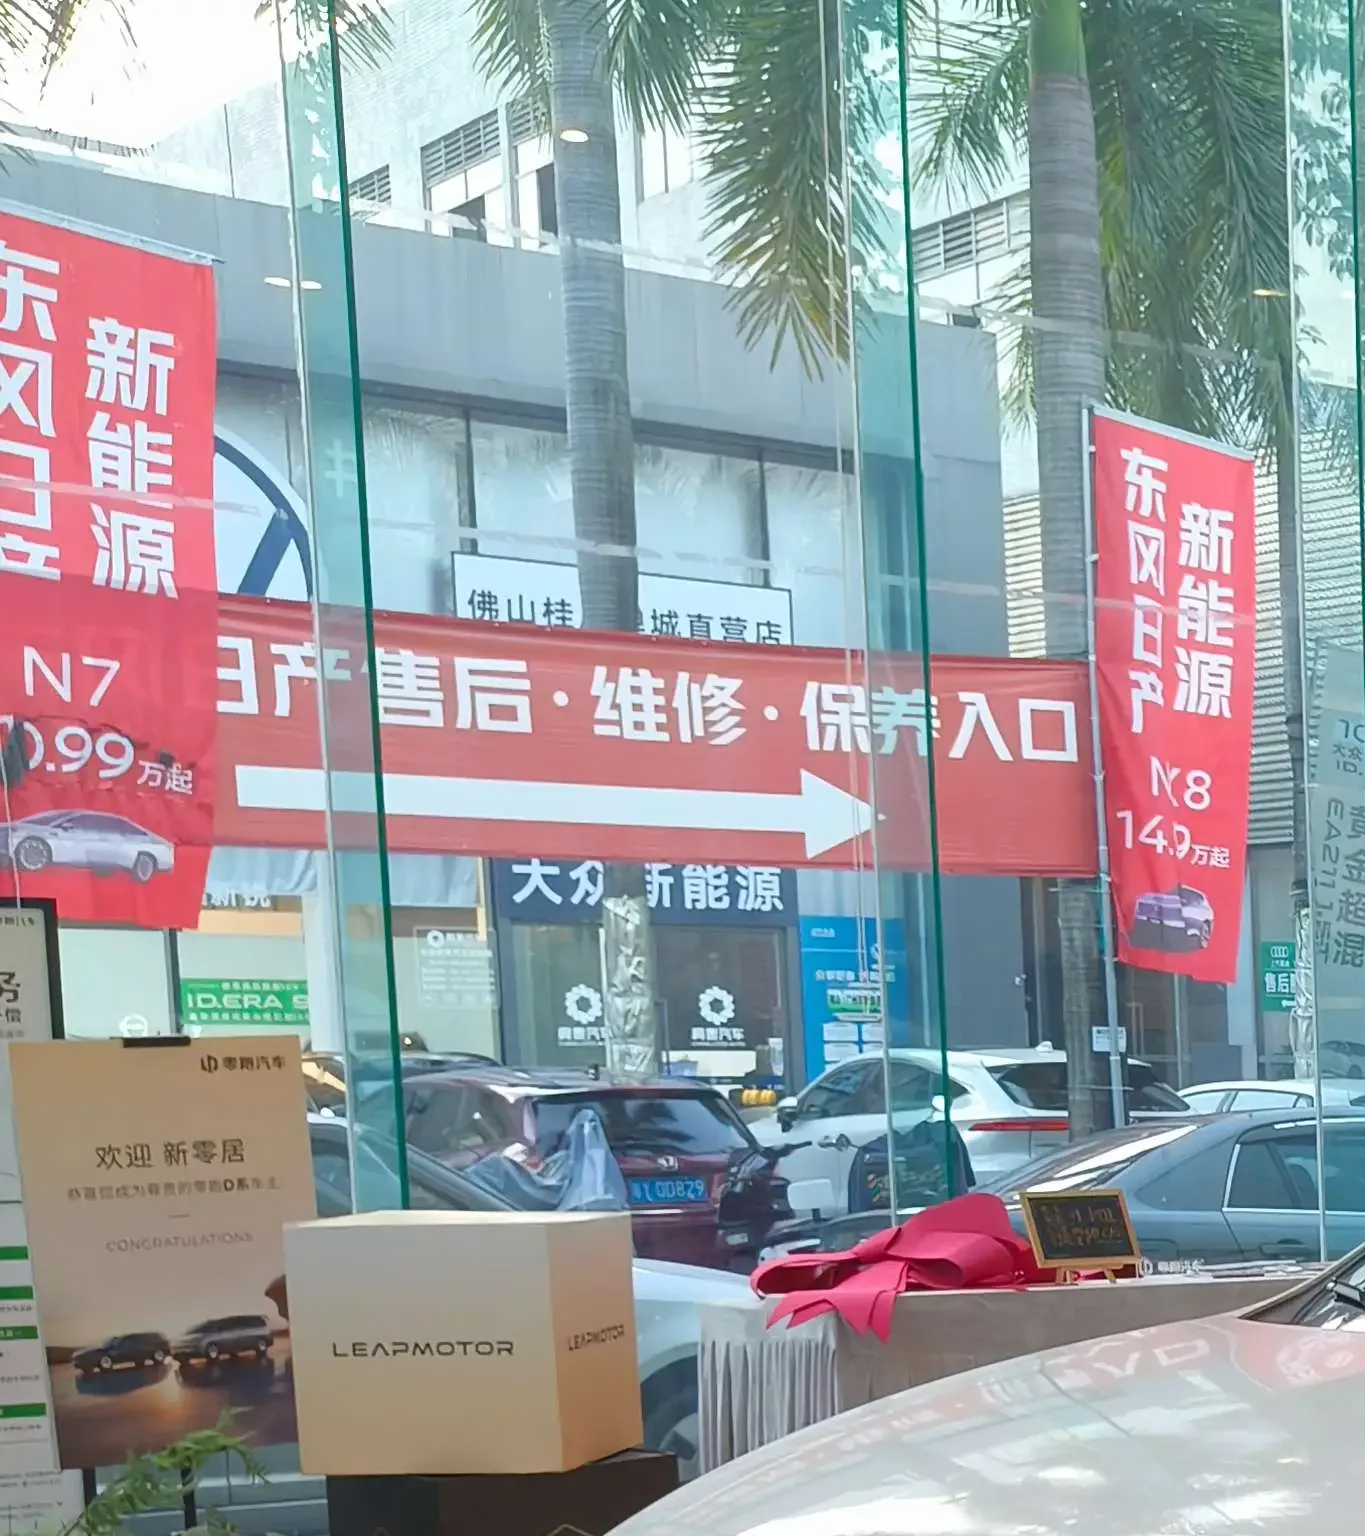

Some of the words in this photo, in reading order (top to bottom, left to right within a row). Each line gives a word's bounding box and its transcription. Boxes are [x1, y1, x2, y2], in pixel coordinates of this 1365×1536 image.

[86, 315, 180, 599] 新能源
[1120, 447, 1169, 734] 东风日产
[1173, 500, 1235, 719] 新能源
[23, 645, 122, 706] N7
[1150, 755, 1214, 811] N8
[95, 1143, 153, 1171] 欢迎
[162, 1138, 246, 1168] 新零居
[106, 1231, 254, 1252] CONGRATULATIONS
[332, 1341, 515, 1358] LEAPMOTOR
[568, 1324, 625, 1351] LEAPMOTOR
